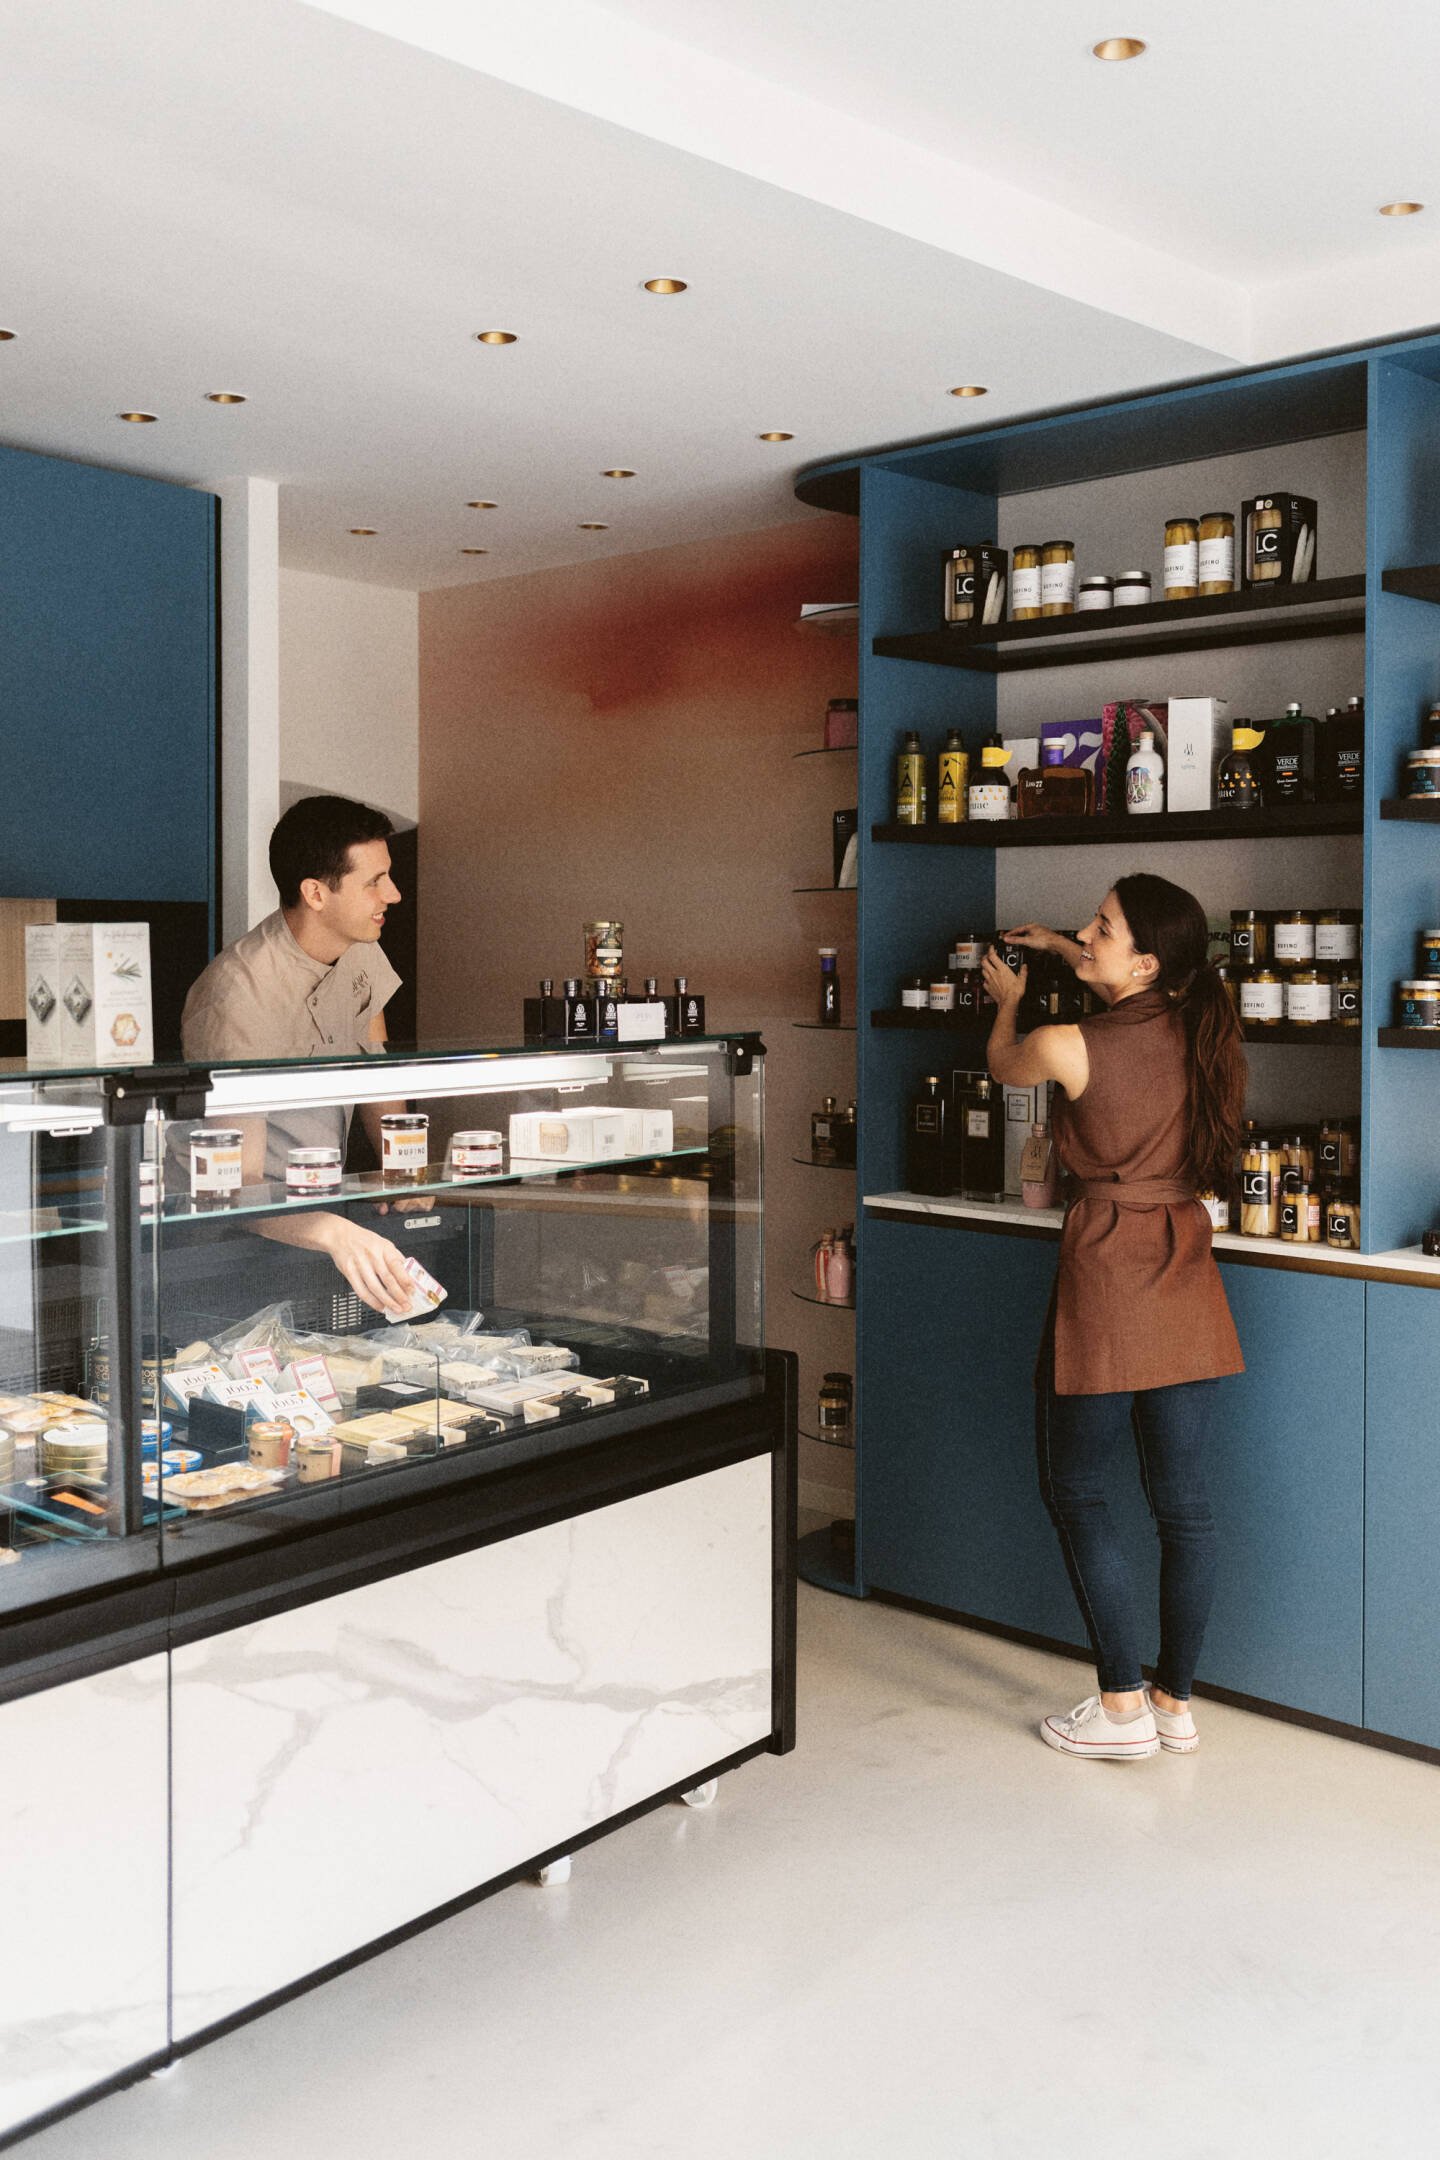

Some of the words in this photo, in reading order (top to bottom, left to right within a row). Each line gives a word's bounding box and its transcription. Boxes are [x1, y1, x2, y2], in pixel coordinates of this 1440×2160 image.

[1255, 533, 1278, 554] LC
[956, 577, 975, 595] LC
[1276, 757, 1298, 766] VERDE
[1338, 752, 1360, 760] VERDE
[1233, 933, 1249, 946] LC
[959, 993, 972, 1005] LC
[1338, 993, 1356, 1010] LC
[1244, 1175, 1267, 1195] LC
[1330, 1216, 1346, 1233] LC
